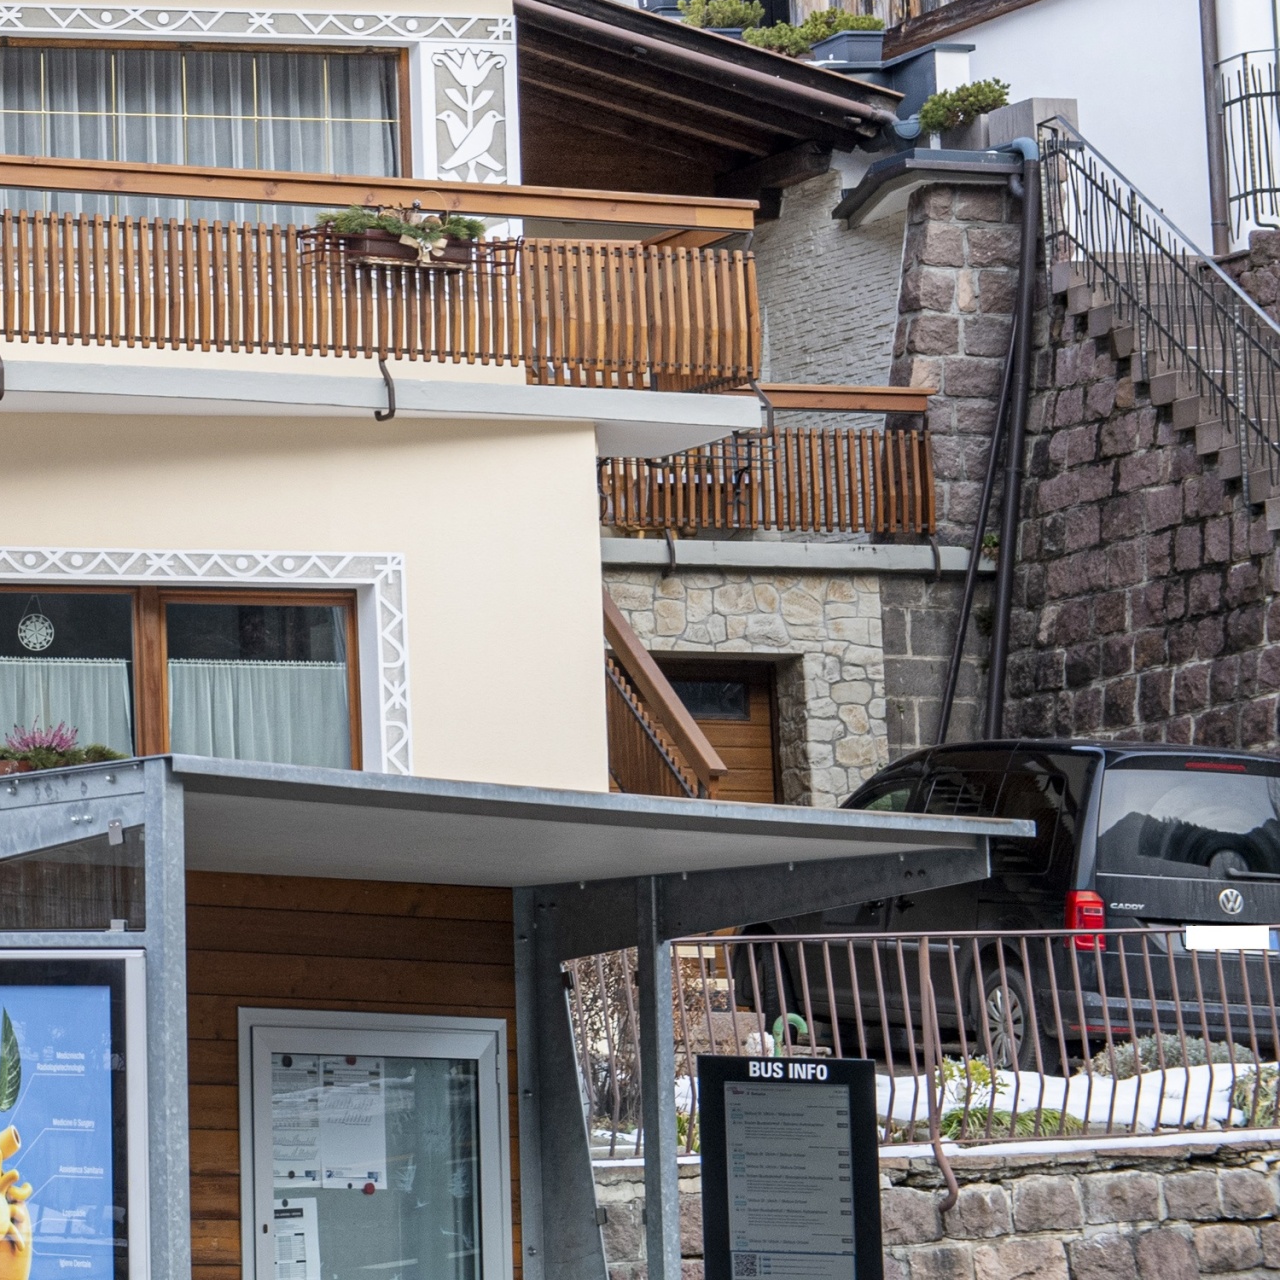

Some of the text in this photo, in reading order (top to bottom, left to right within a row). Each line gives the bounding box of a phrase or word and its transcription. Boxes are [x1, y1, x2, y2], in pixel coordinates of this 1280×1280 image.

[1110, 902, 1145, 910] CADDY
[749, 1061, 828, 1080] BUS INFO
